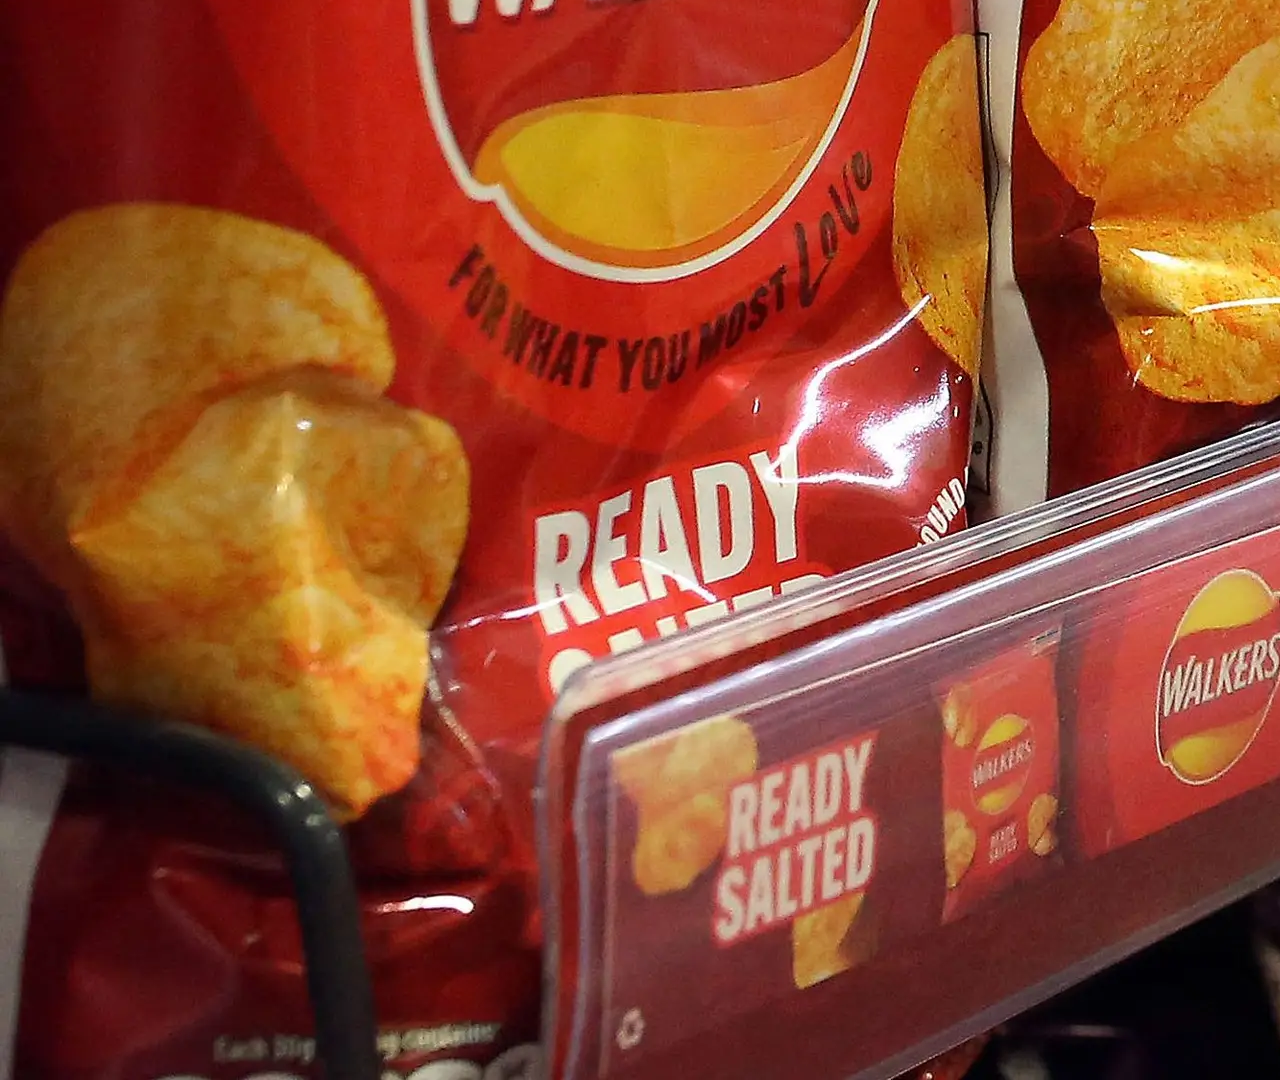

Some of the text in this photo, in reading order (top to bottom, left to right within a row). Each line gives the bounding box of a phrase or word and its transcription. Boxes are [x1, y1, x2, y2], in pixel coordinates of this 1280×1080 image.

[449, 243, 510, 340] FOR
[503, 304, 607, 390] WHAT
[617, 330, 691, 393] YOU
[696, 265, 788, 370] MOST
[533, 442, 799, 635] READY
[915, 477, 966, 549] OUND
[728, 738, 873, 858] READY
[716, 817, 875, 941] SALTED
